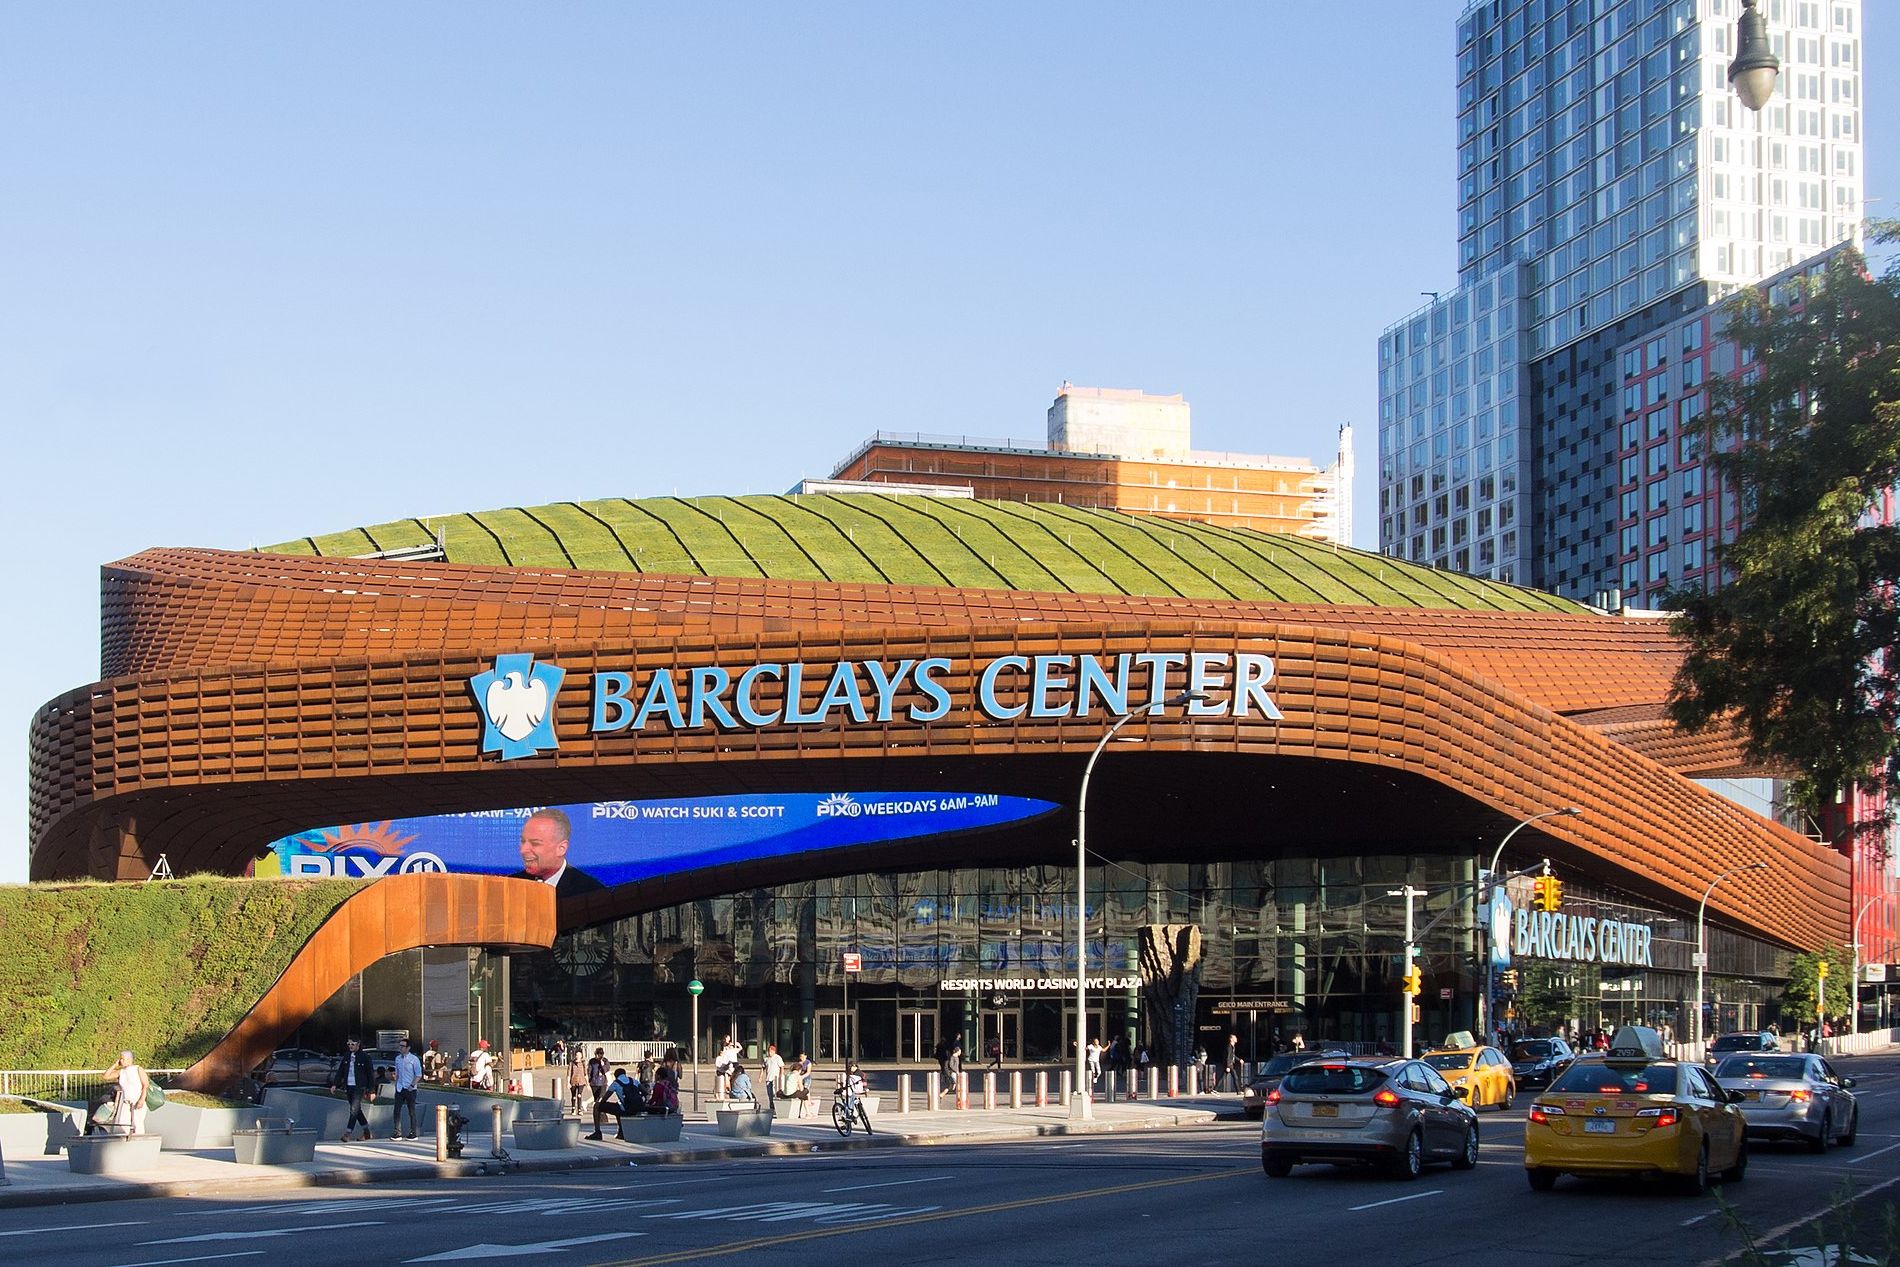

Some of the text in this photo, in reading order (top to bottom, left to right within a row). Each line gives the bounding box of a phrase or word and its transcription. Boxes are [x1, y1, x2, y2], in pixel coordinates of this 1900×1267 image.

[591, 652, 1285, 732] BARCLAYS CENTER
[642, 807, 690, 818] WATCH
[692, 807, 724, 818] SUKI
[727, 806, 738, 818] &
[740, 806, 785, 818] SCOTT
[863, 800, 937, 816] WEEKDAYS
[1514, 908, 1653, 968] BARCLAYS CENTER
[940, 979, 993, 991] RESORTS
[993, 978, 1036, 990] WORLD
[1037, 978, 1079, 990] CASINO
[1105, 977, 1143, 989] PLAZA
